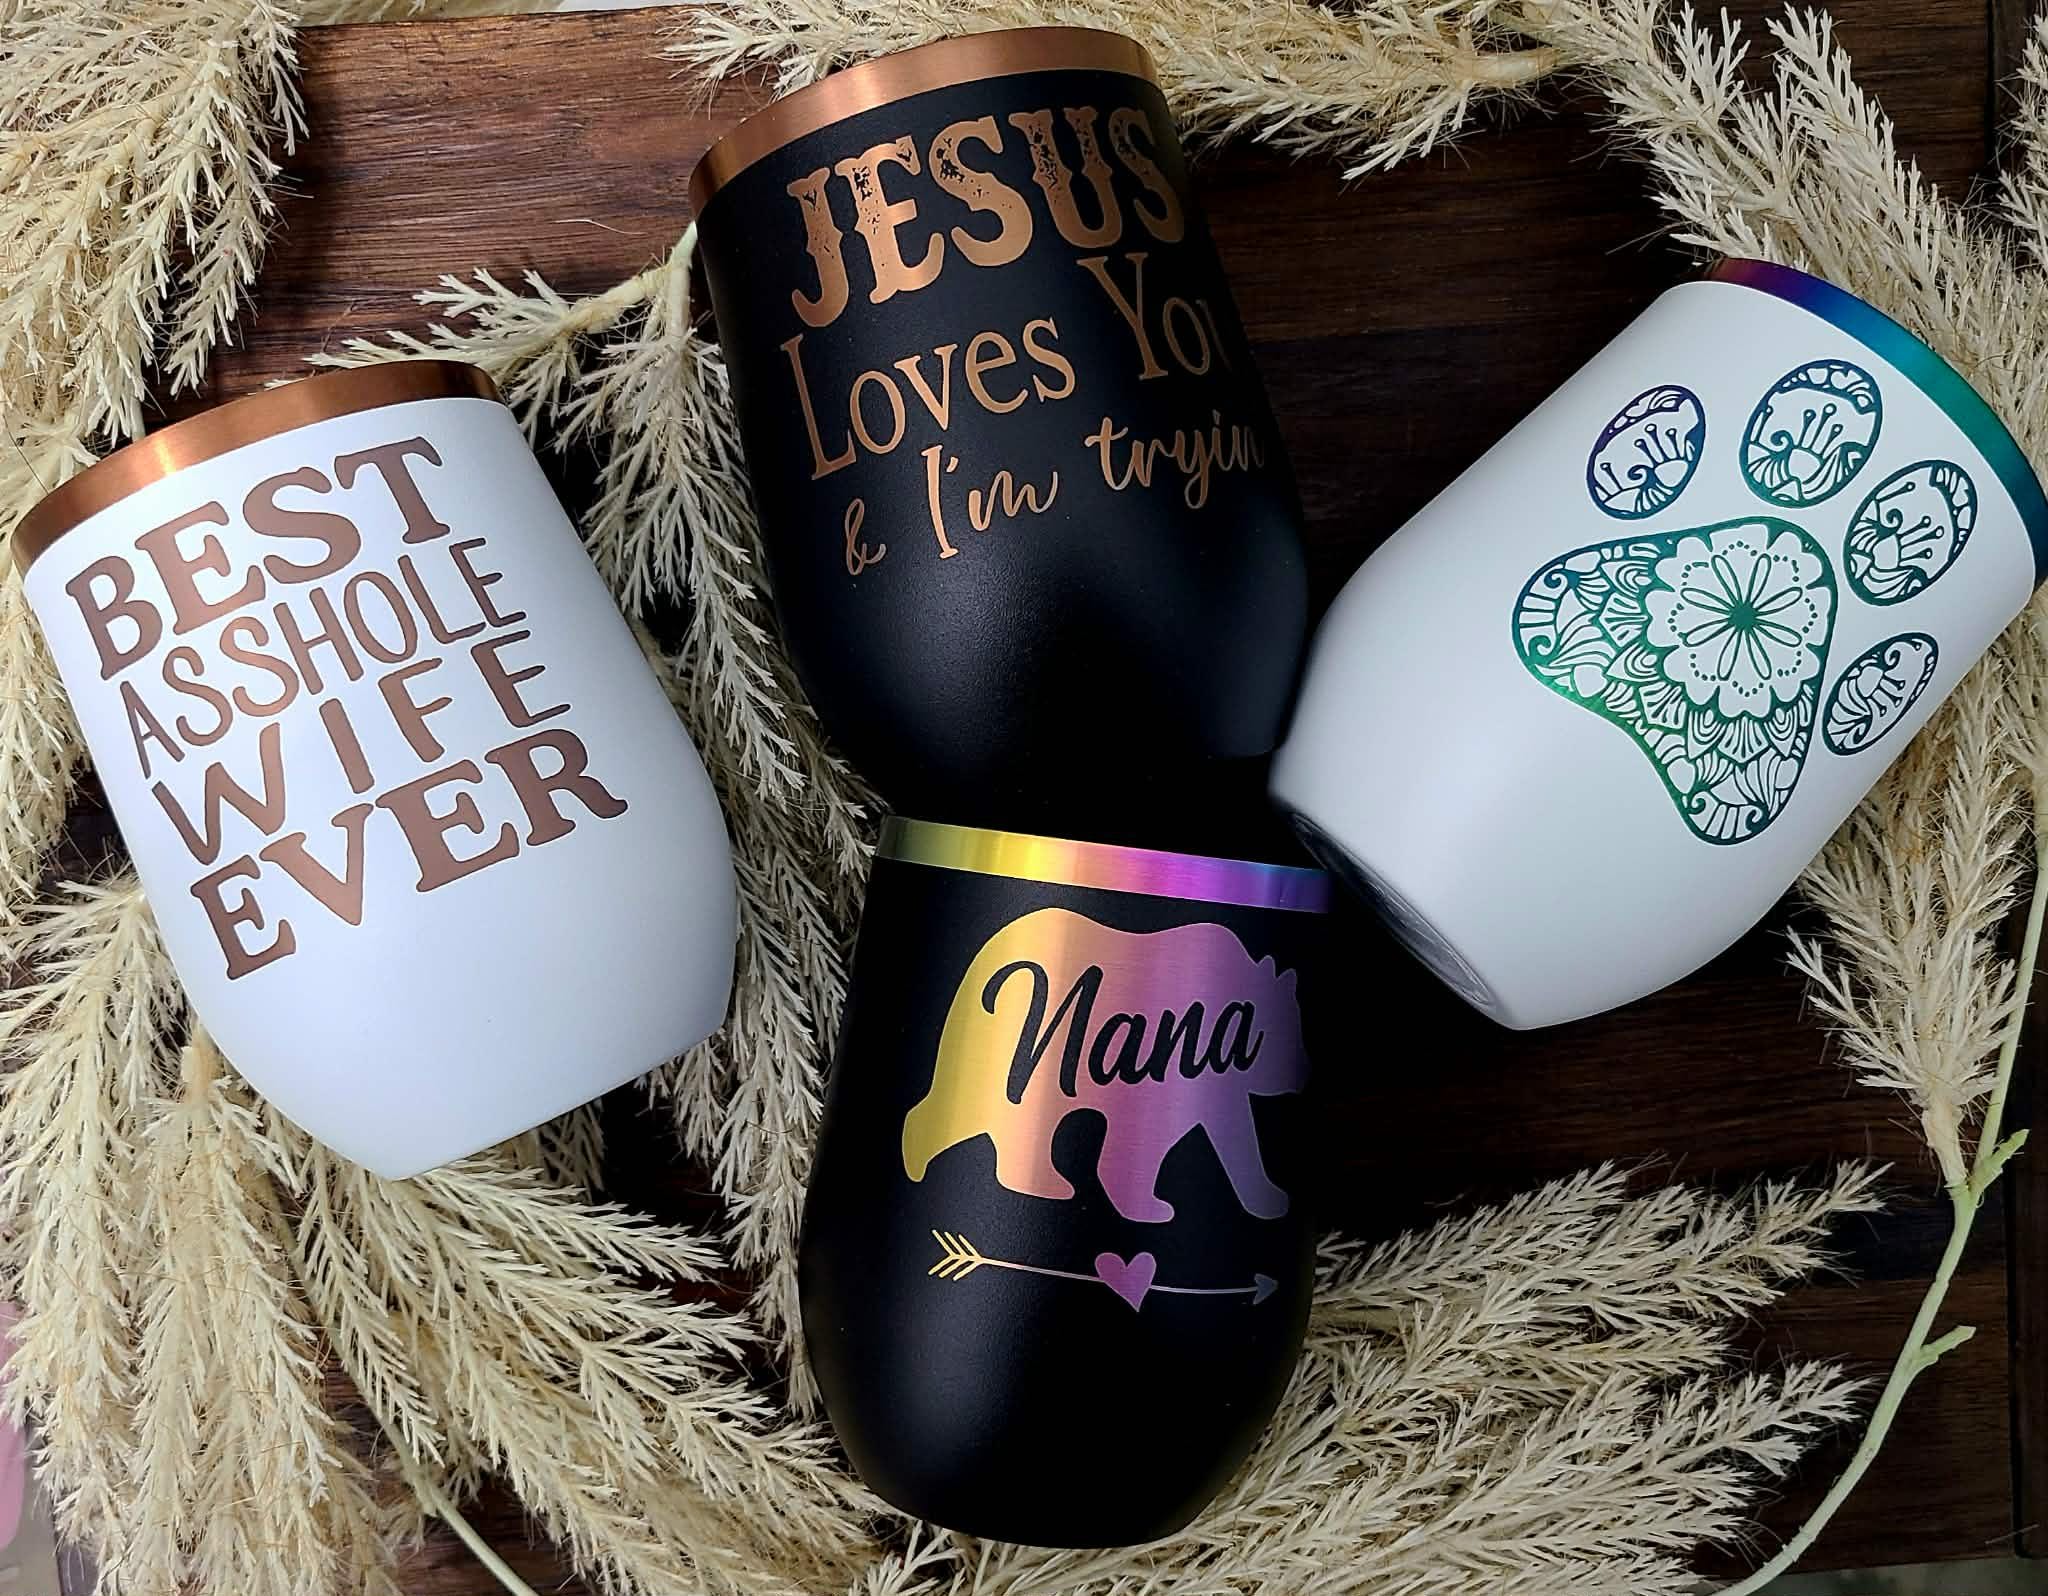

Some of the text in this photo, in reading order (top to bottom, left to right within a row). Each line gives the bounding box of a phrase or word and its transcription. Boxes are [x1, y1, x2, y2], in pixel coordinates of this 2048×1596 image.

[787, 106, 1184, 328] JESUS
[780, 316, 1076, 481] Loves
[844, 498, 887, 576] &
[921, 444, 1058, 560] I'm
[65, 435, 451, 681] BEST
[119, 537, 527, 779] ASSHOLE
[151, 629, 571, 866] WIFE
[190, 728, 628, 981] EVER
[981, 960, 1264, 1105] Nana
